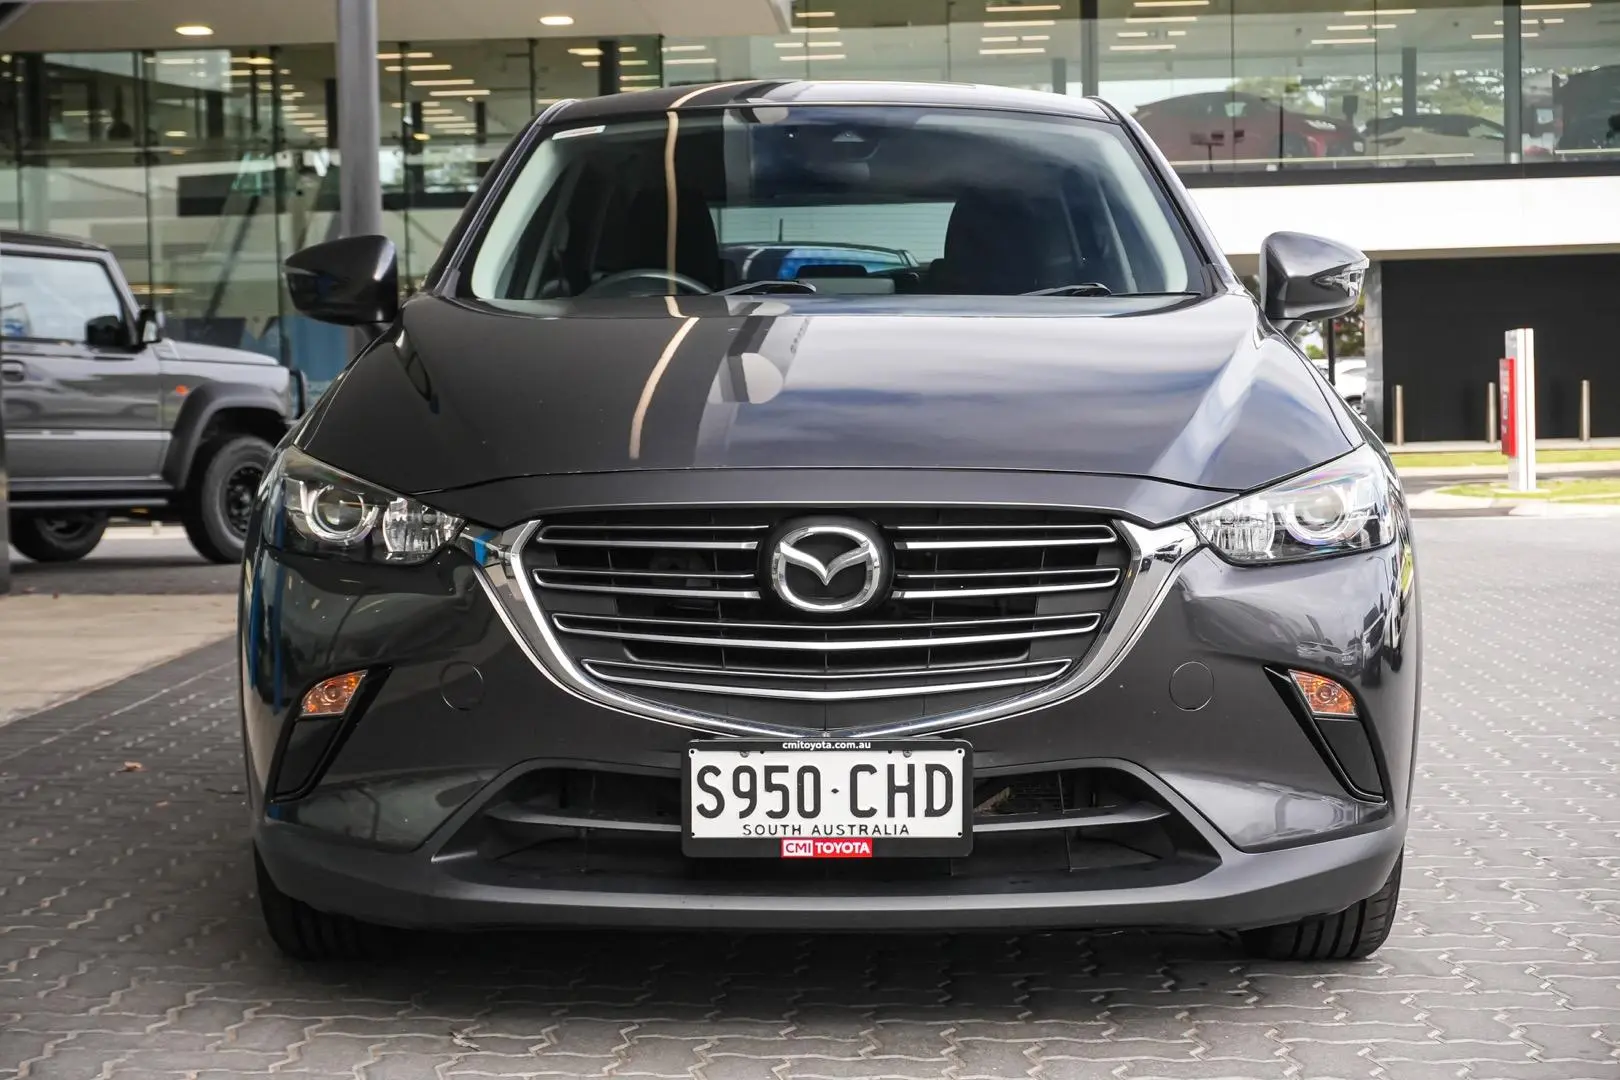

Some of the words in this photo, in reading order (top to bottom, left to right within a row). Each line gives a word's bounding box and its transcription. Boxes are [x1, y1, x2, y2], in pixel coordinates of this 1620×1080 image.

[782, 740, 871, 750] cmitoyota.com.au
[743, 824, 801, 836] SOUTH
[812, 824, 910, 836] AUSTRALIA
[785, 842, 812, 855] CMI
[815, 842, 870, 855] TOYOTA
